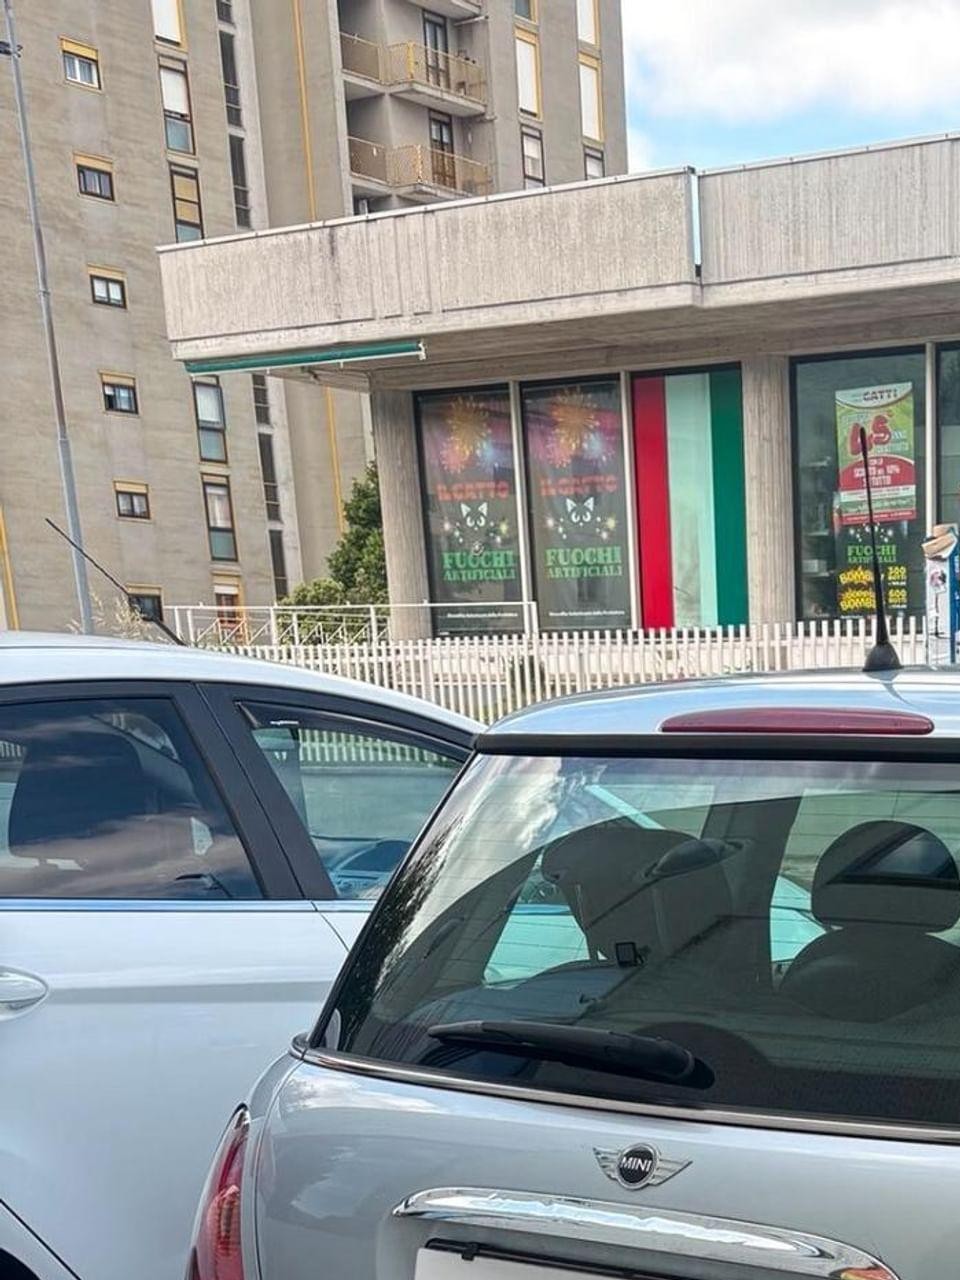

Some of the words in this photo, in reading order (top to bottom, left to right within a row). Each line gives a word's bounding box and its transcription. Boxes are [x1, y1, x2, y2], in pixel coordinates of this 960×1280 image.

[443, 550, 516, 569] FUOCHI
[545, 546, 622, 566] FUOCHI
[443, 568, 516, 581] ARTIFICIALI
[547, 565, 622, 579] ARTIFICIALI
[620, 1157, 652, 1172] MINI
